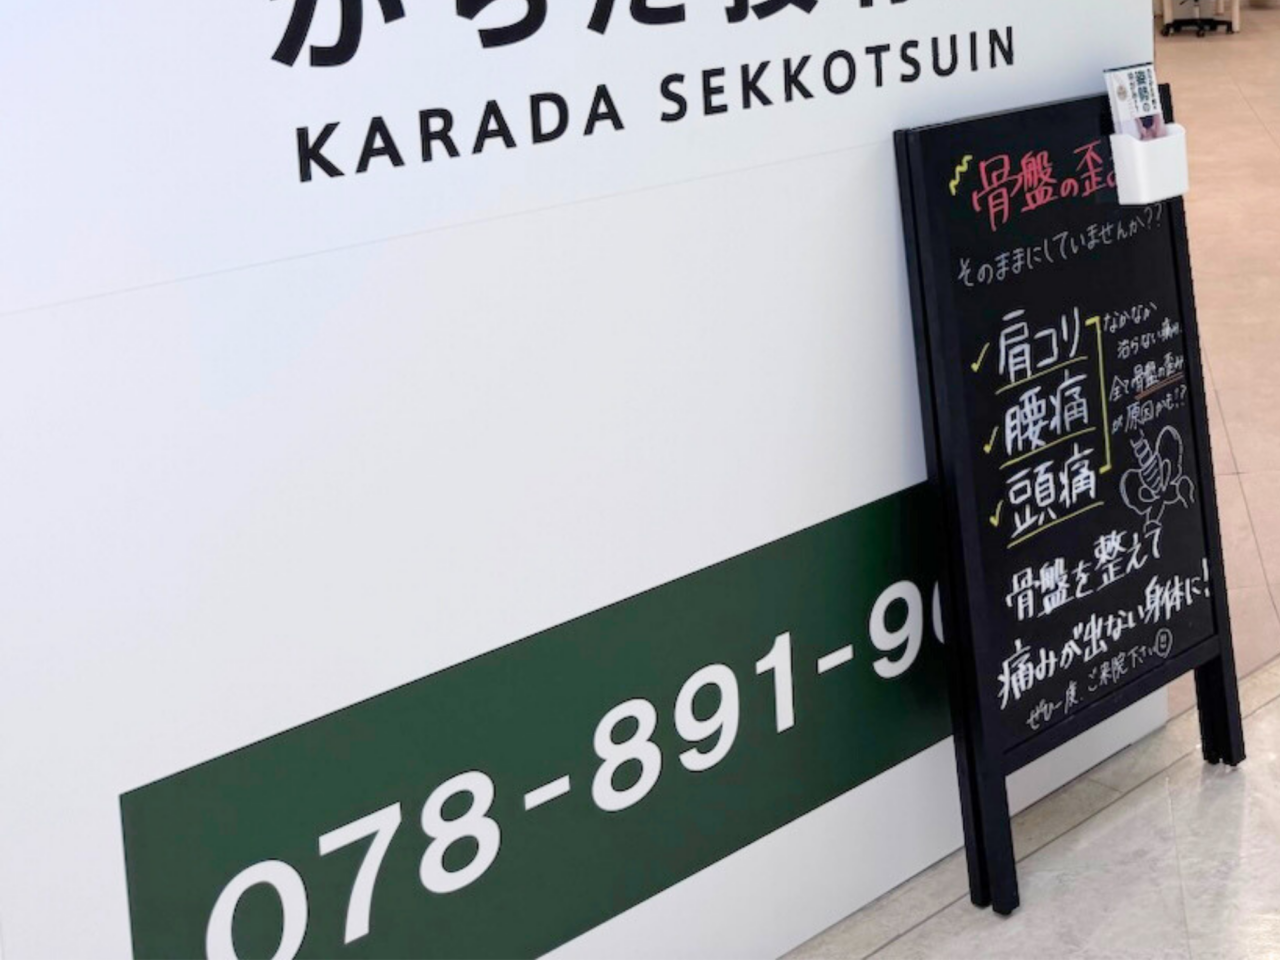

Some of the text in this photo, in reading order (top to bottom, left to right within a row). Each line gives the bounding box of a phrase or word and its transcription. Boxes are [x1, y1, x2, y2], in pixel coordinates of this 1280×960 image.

[295, 83, 626, 184] KARADA
[659, 25, 1017, 122] SEKKOTSUIN
[971, 140, 1117, 232] 骨盤の歪
[999, 306, 1080, 382] 肩コリ
[1103, 301, 1158, 333] なかなか
[1005, 369, 1090, 455] 腰痛
[1006, 442, 1096, 538] 頭痛
[1005, 527, 1162, 621] 骨盤を整えて
[997, 557, 1210, 710] 痛みが出ない身体に!
[204, 578, 945, 960] 078-891-9
